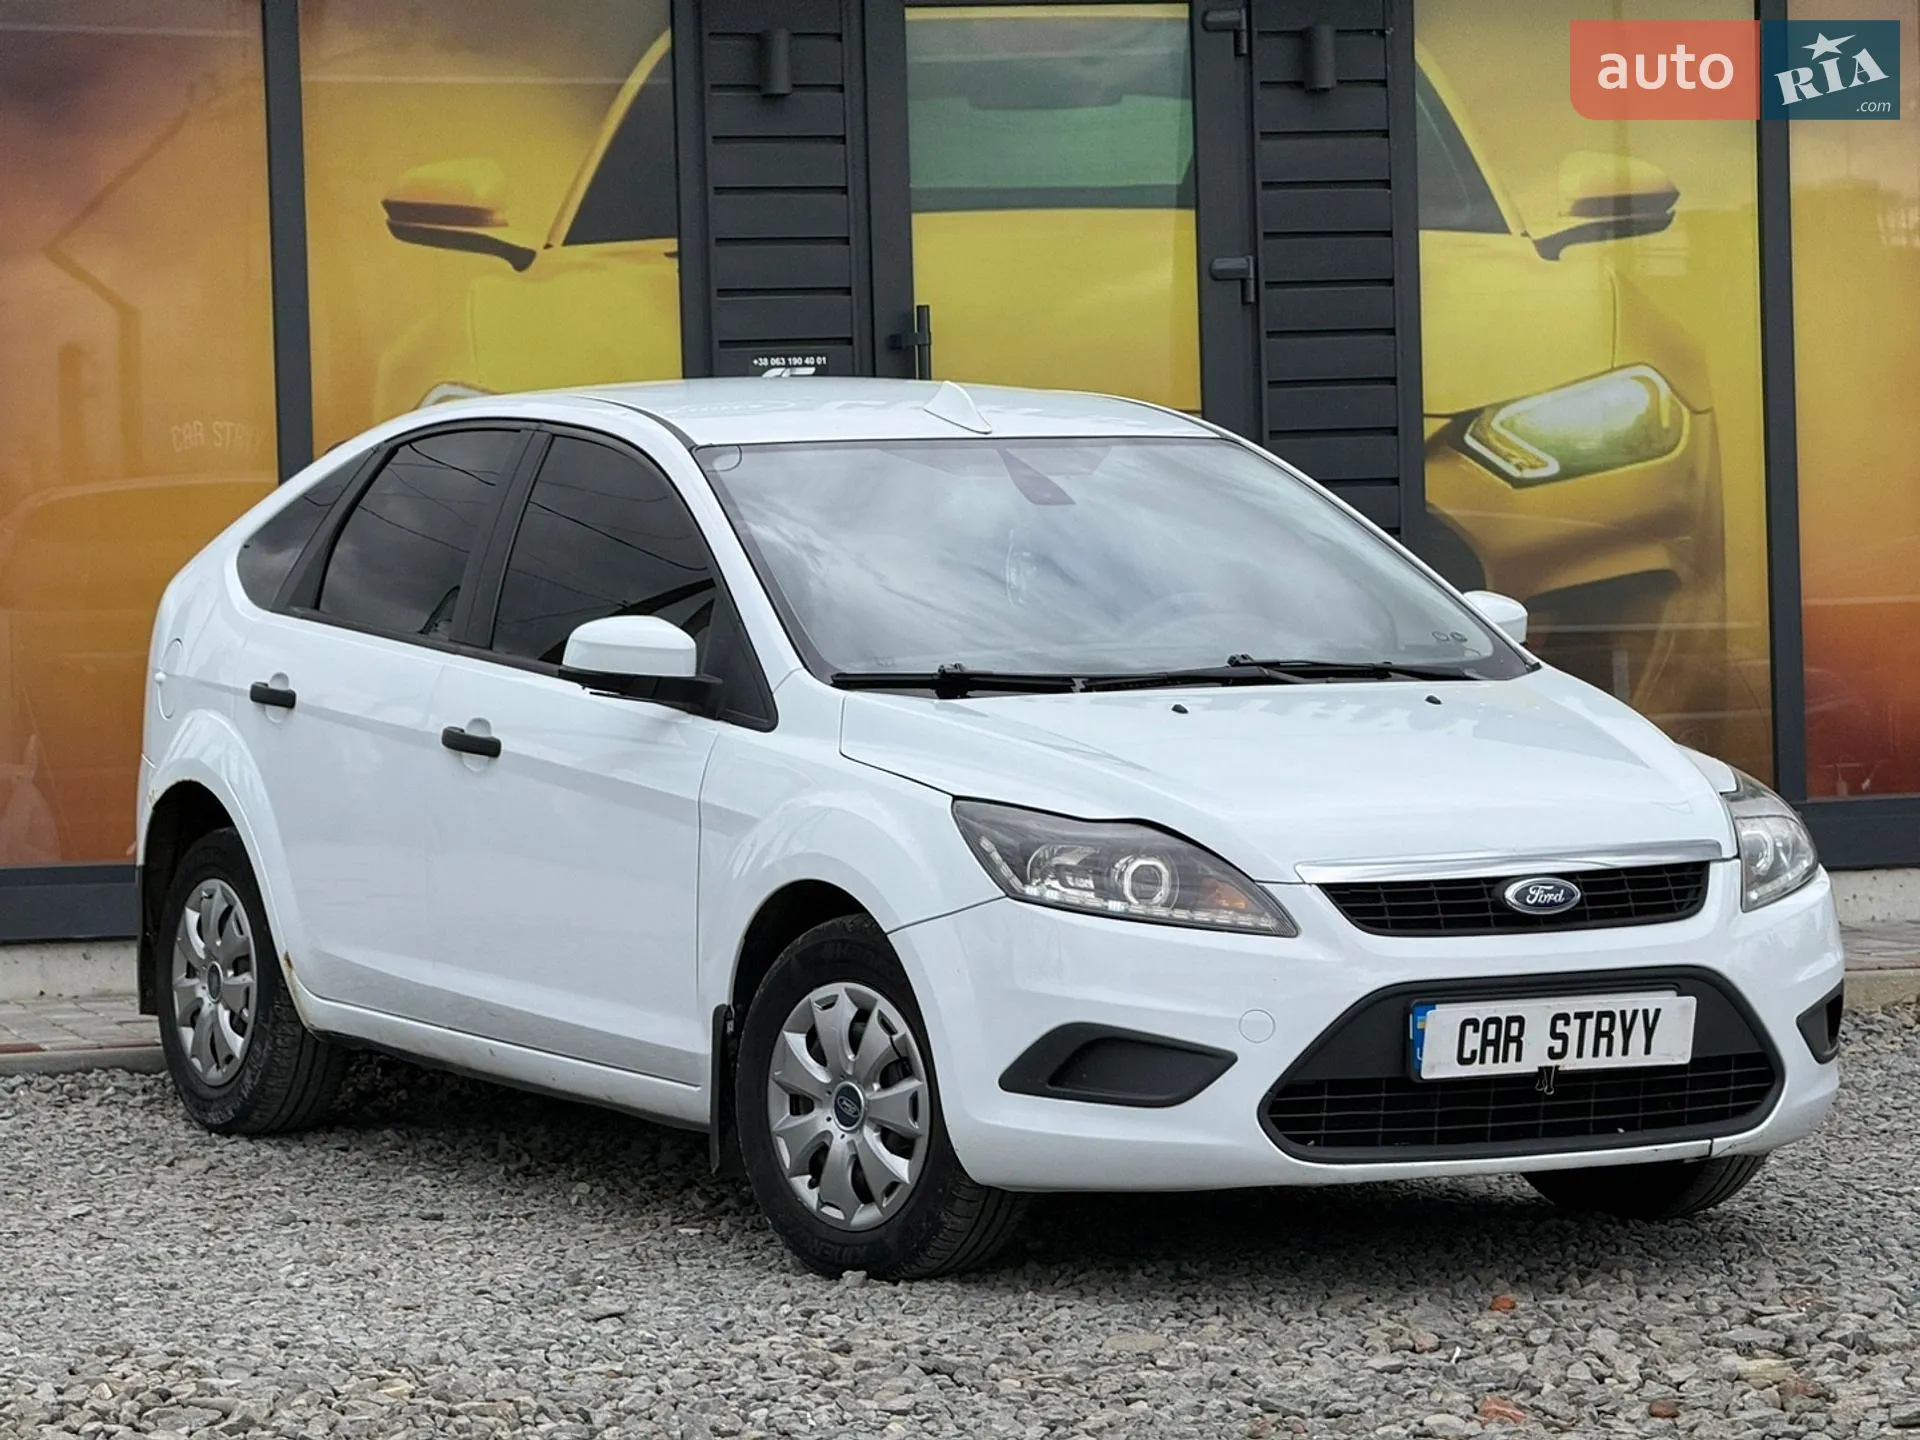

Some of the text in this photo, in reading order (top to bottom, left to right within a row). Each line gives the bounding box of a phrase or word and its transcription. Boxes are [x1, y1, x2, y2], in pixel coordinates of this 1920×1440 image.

[753, 356, 827, 367] +38 063 190 40 01
[1526, 885, 1565, 905] Ford
[1456, 1007, 1662, 1067] CAR STRYY
